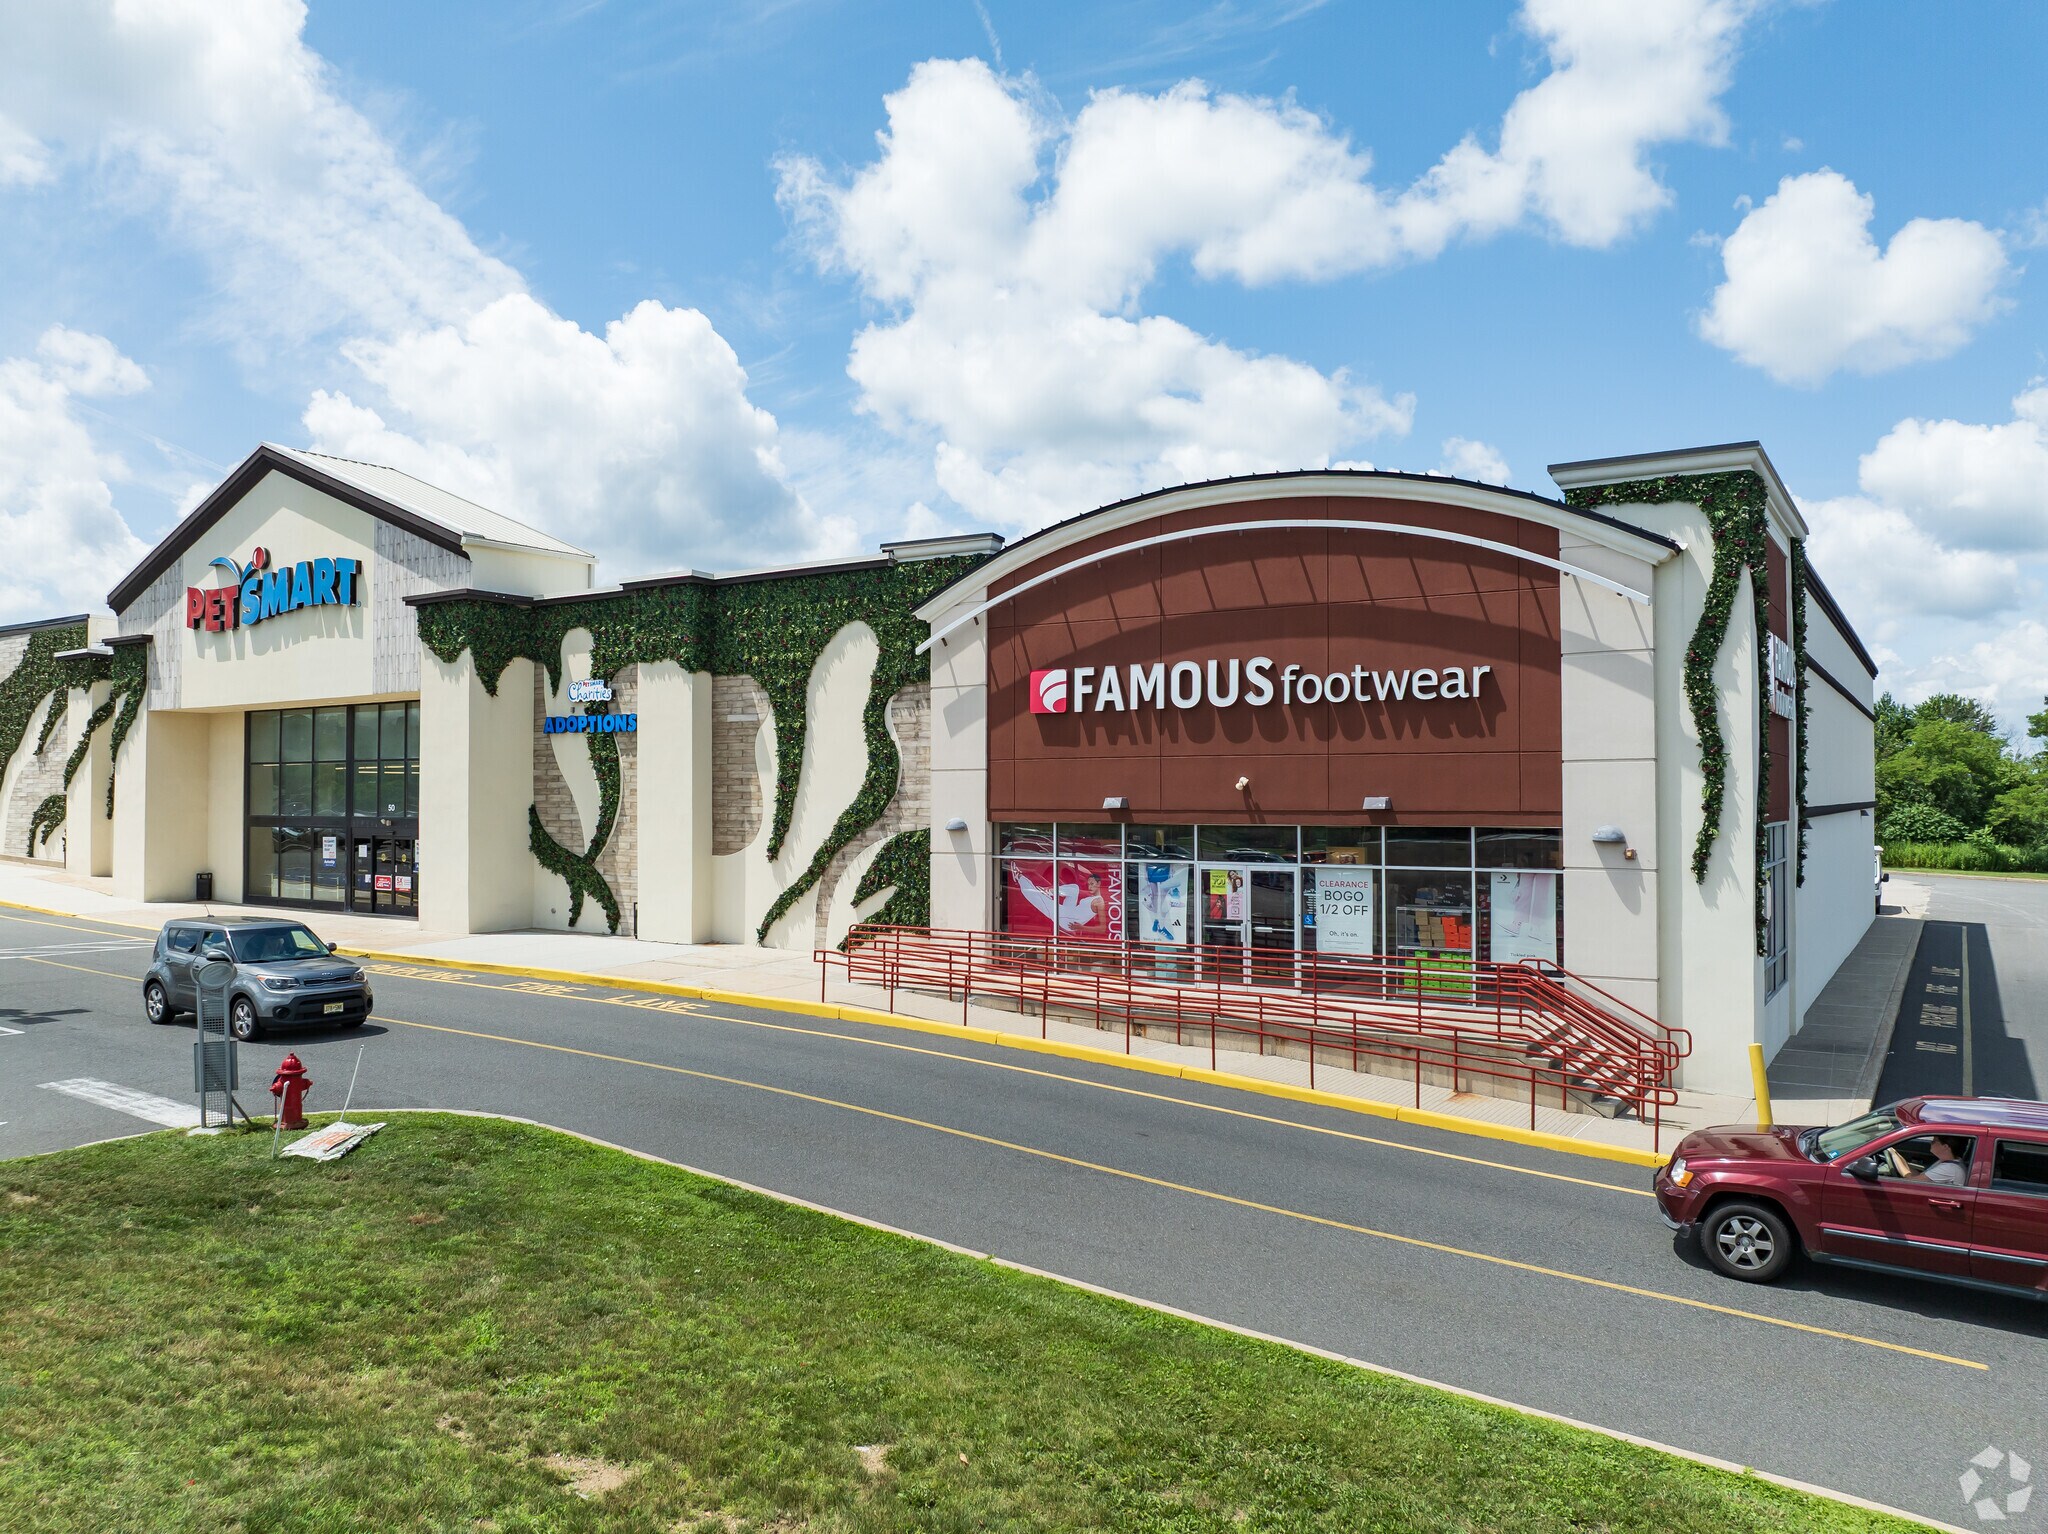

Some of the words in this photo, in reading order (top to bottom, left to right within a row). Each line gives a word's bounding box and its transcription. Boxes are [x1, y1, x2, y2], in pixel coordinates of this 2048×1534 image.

[187, 556, 362, 632] PETSMART
[568, 682, 612, 701] Charities
[1074, 656, 1275, 713] FAMOUS
[1281, 664, 1491, 705] footwear
[543, 713, 637, 734] ADOPTIONS
[1319, 880, 1369, 889] CLEARANCE
[1324, 890, 1364, 901] BOGO
[1320, 904, 1339, 915] 1/2
[1343, 905, 1369, 915] OFF
[502, 981, 588, 995] FIRE
[604, 994, 711, 1012] LANE
